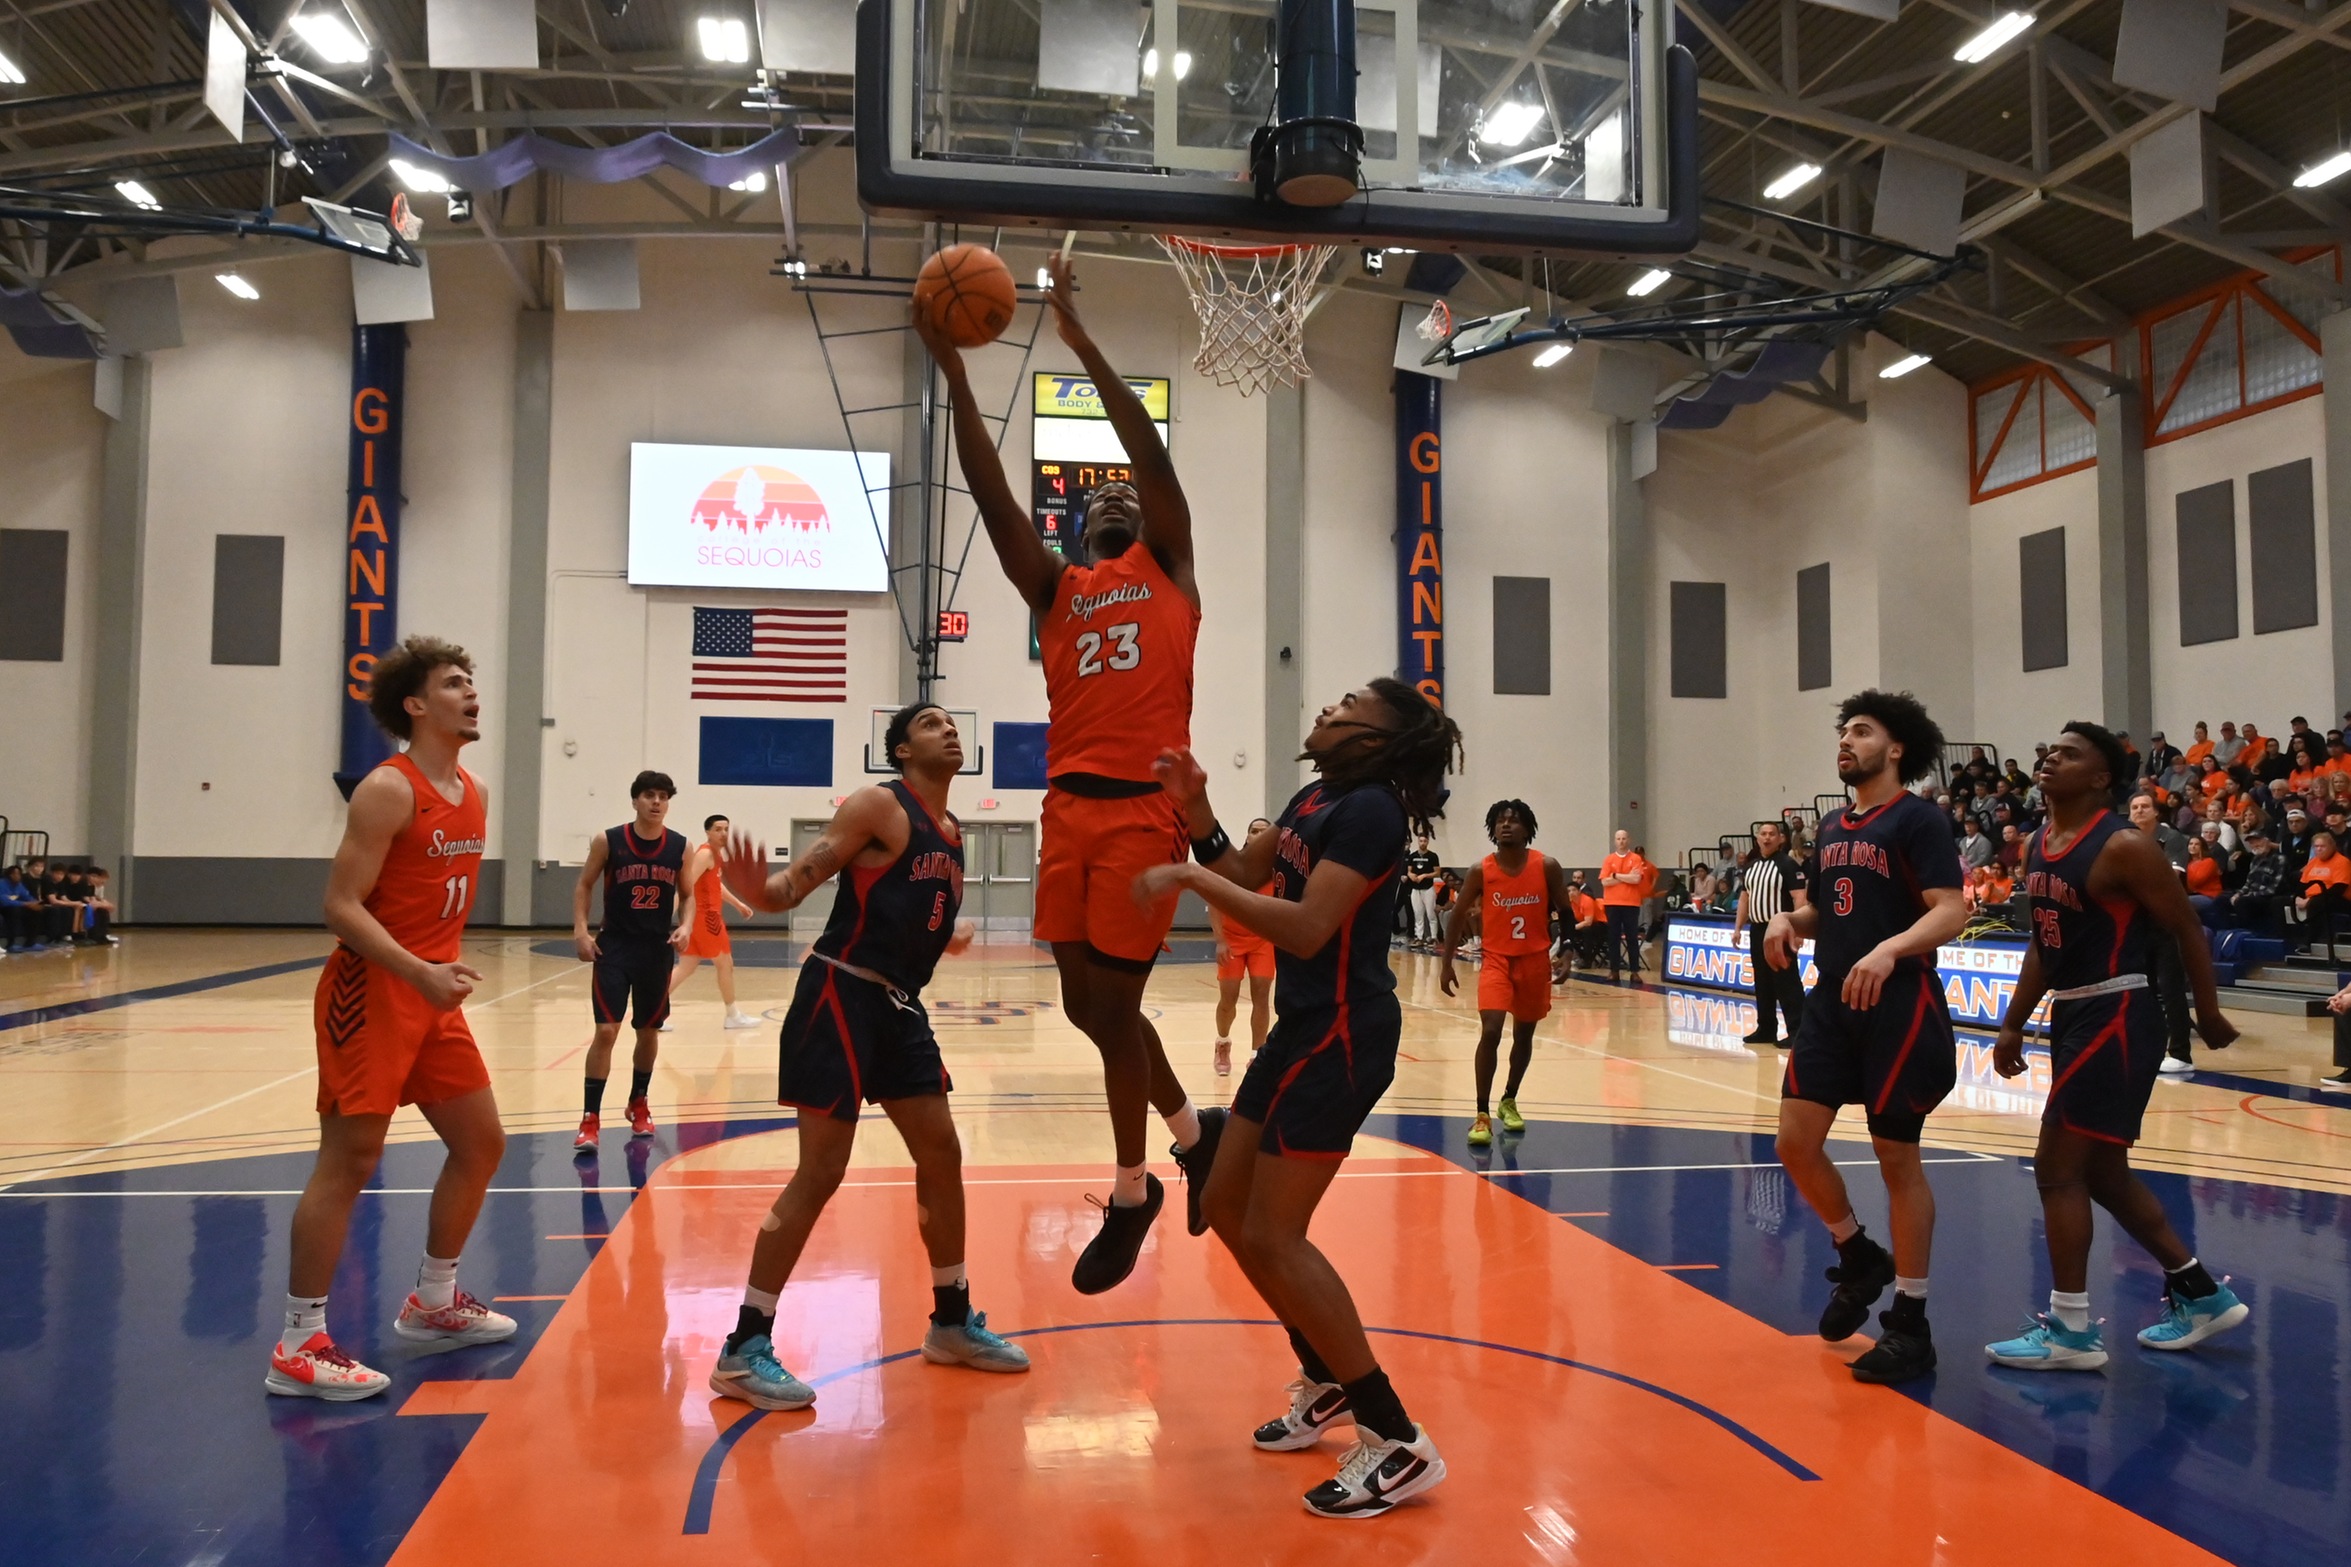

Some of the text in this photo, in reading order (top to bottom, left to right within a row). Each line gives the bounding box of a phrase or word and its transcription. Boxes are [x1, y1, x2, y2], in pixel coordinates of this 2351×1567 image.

[1057, 399, 1092, 408] BODY
[1041, 465, 1061, 475] COS
[1052, 478, 1065, 496] 4
[1036, 508, 1067, 516] TIMEOUTS
[1046, 497, 1067, 505] BONUS
[1045, 514, 1057, 530] 6
[349, 387, 389, 701] GIANTS
[1043, 539, 1062, 547] FOULS
[697, 546, 822, 569] SEQUOIAS
[939, 613, 966, 635] 30
[1076, 622, 1141, 677] 23
[1850, 840, 1890, 879] ROSA
[440, 873, 468, 919] 11
[630, 885, 661, 910] 22
[1491, 891, 1541, 912] Sequoias
[1833, 876, 1854, 917] 3
[927, 890, 947, 932] 5
[1510, 916, 1526, 940] 2
[1679, 927, 1708, 943] HOME
[1711, 931, 1726, 943] OF
[1668, 946, 1755, 986] GIANTS
[1974, 952, 1998, 969] OF
